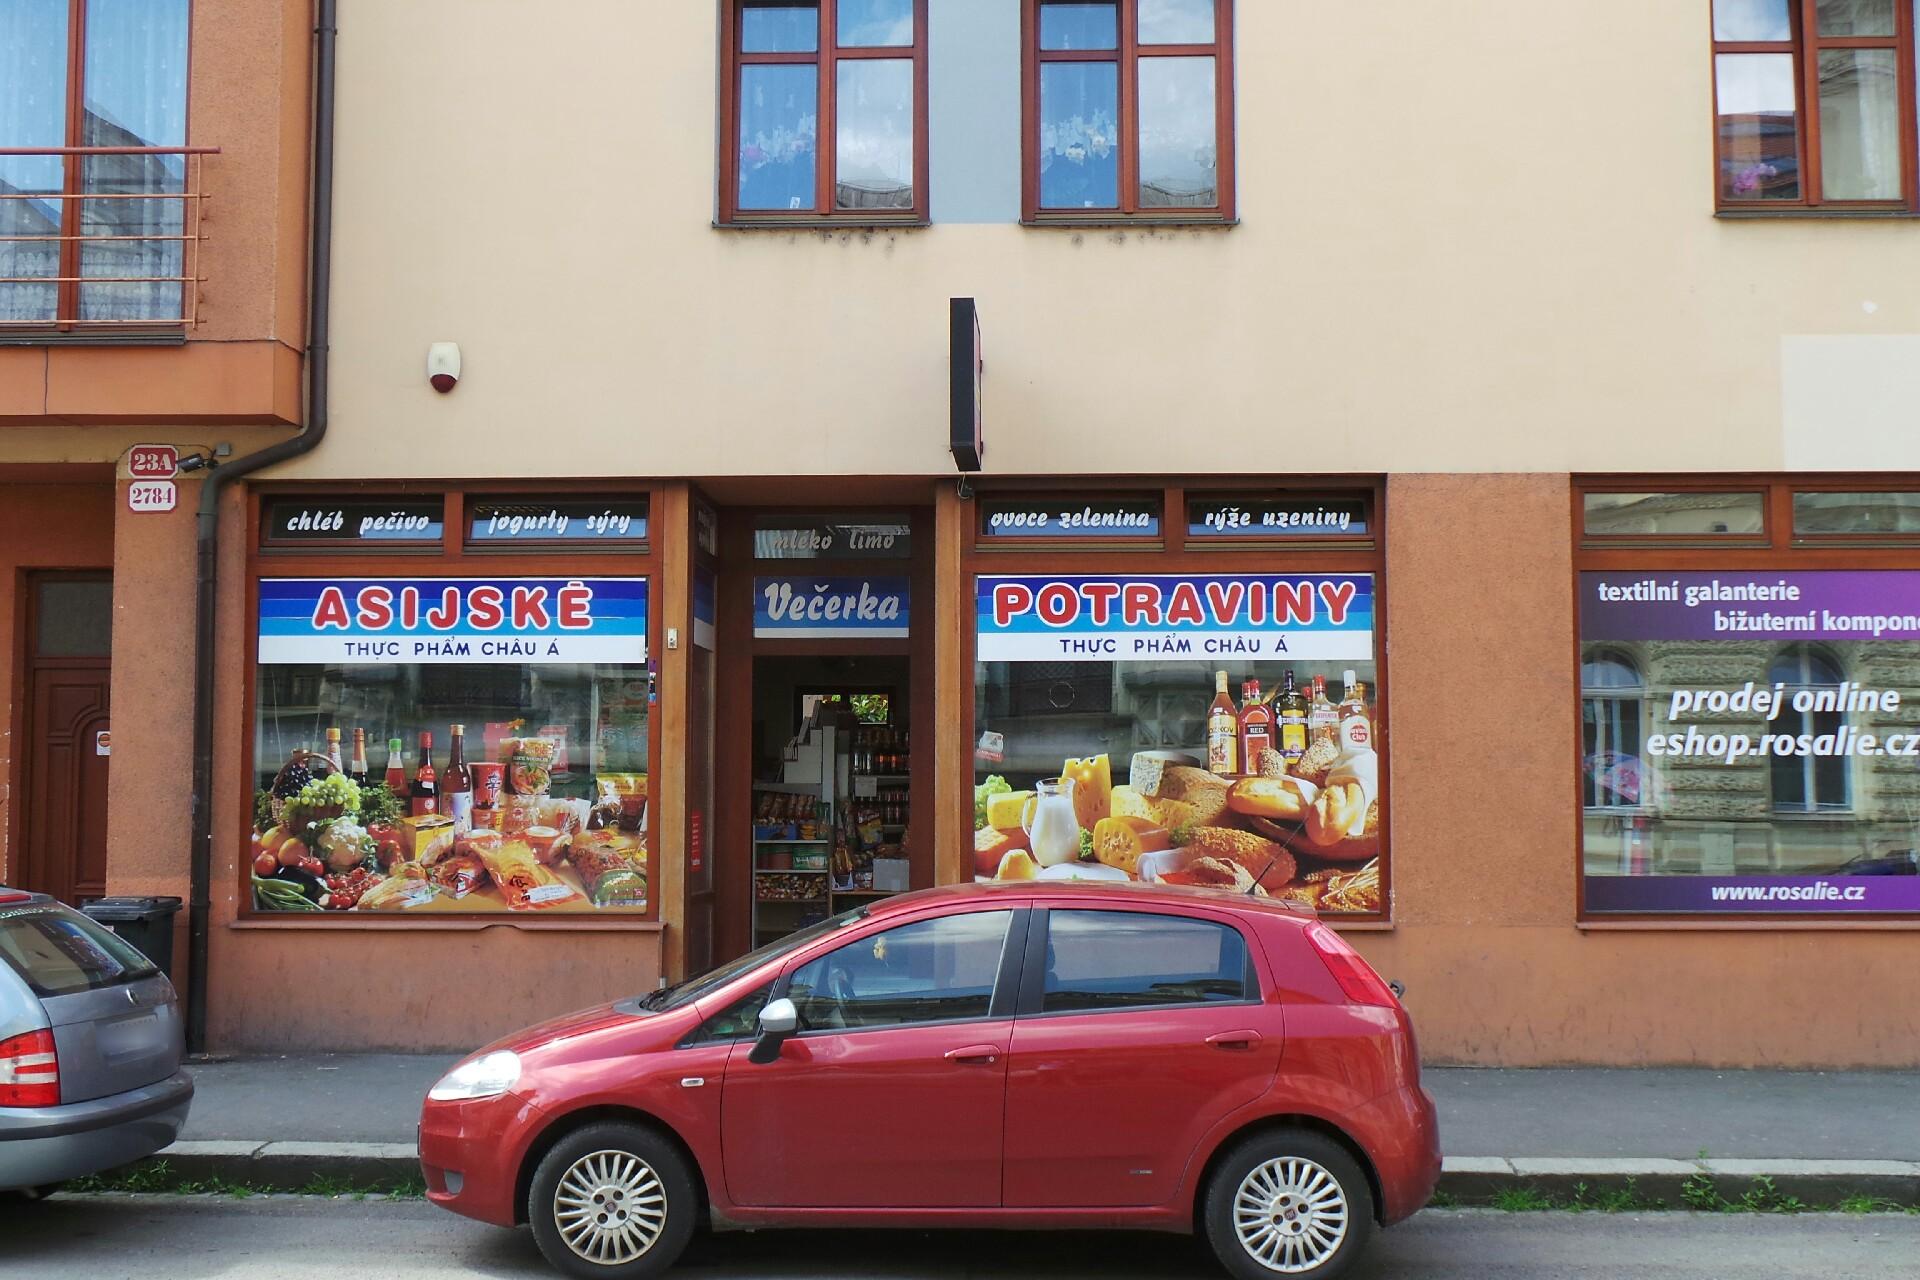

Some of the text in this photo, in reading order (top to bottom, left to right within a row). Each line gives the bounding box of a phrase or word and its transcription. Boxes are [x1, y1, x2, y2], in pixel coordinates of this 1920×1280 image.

[134, 453, 173, 471] 23A
[132, 487, 171, 504] 2784
[287, 510, 430, 535] chléb pečivo
[488, 510, 631, 535] jogurty sýry
[991, 508, 1150, 528] ovoce zelenina
[1205, 506, 1351, 531] rýže uzeniny
[764, 582, 900, 621] Večerka
[992, 580, 1356, 628] POTRAVINY
[1598, 580, 1801, 607] textilní galanterie
[1714, 610, 1817, 632] bižuterní
[481, 639, 537, 656] CHÂU
[547, 638, 560, 656] Á
[1204, 636, 1261, 653] CHÂU
[1275, 635, 1289, 653] Á
[1669, 682, 1901, 721] prodej online
[1647, 725, 1920, 765] eshop.rosalie.cz
[1711, 881, 1866, 900] www.rosalie.cz
